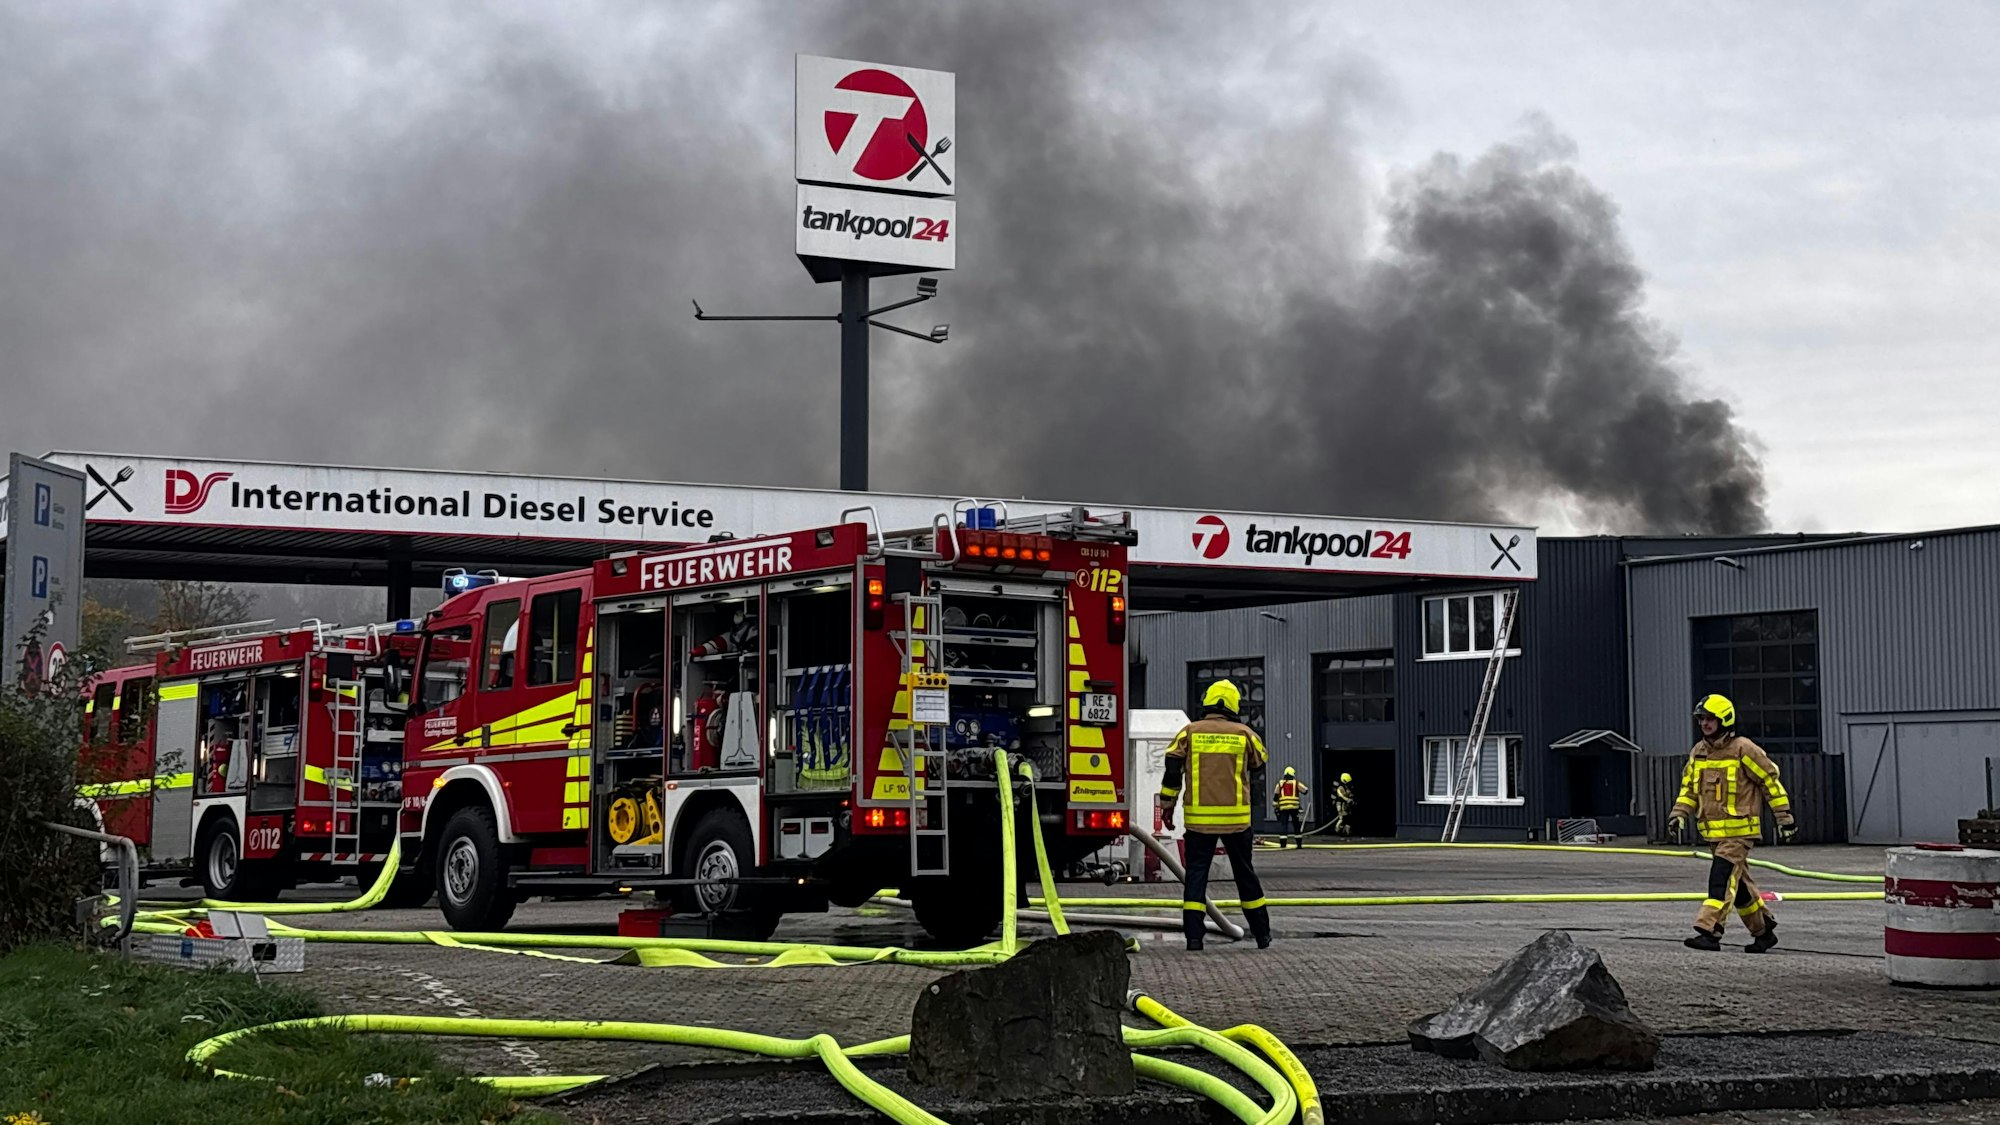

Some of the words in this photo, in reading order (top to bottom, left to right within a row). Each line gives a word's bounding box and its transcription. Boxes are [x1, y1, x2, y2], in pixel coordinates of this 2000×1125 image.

[803, 205, 950, 243] tankpool24
[37, 486, 49, 522] P
[231, 481, 470, 518] International
[483, 493, 586, 523] Diesel
[598, 498, 714, 529] Service
[1245, 523, 1412, 566] tankpool24
[35, 559, 46, 595] P
[640, 536, 793, 590] FEUERWEHR
[1090, 567, 1122, 593] 112
[189, 639, 264, 671] FEUERWEHR
[1087, 708, 1110, 720] 6822
[1092, 695, 1104, 707] RE
[883, 783, 895, 794] LF
[260, 827, 281, 850] 112
